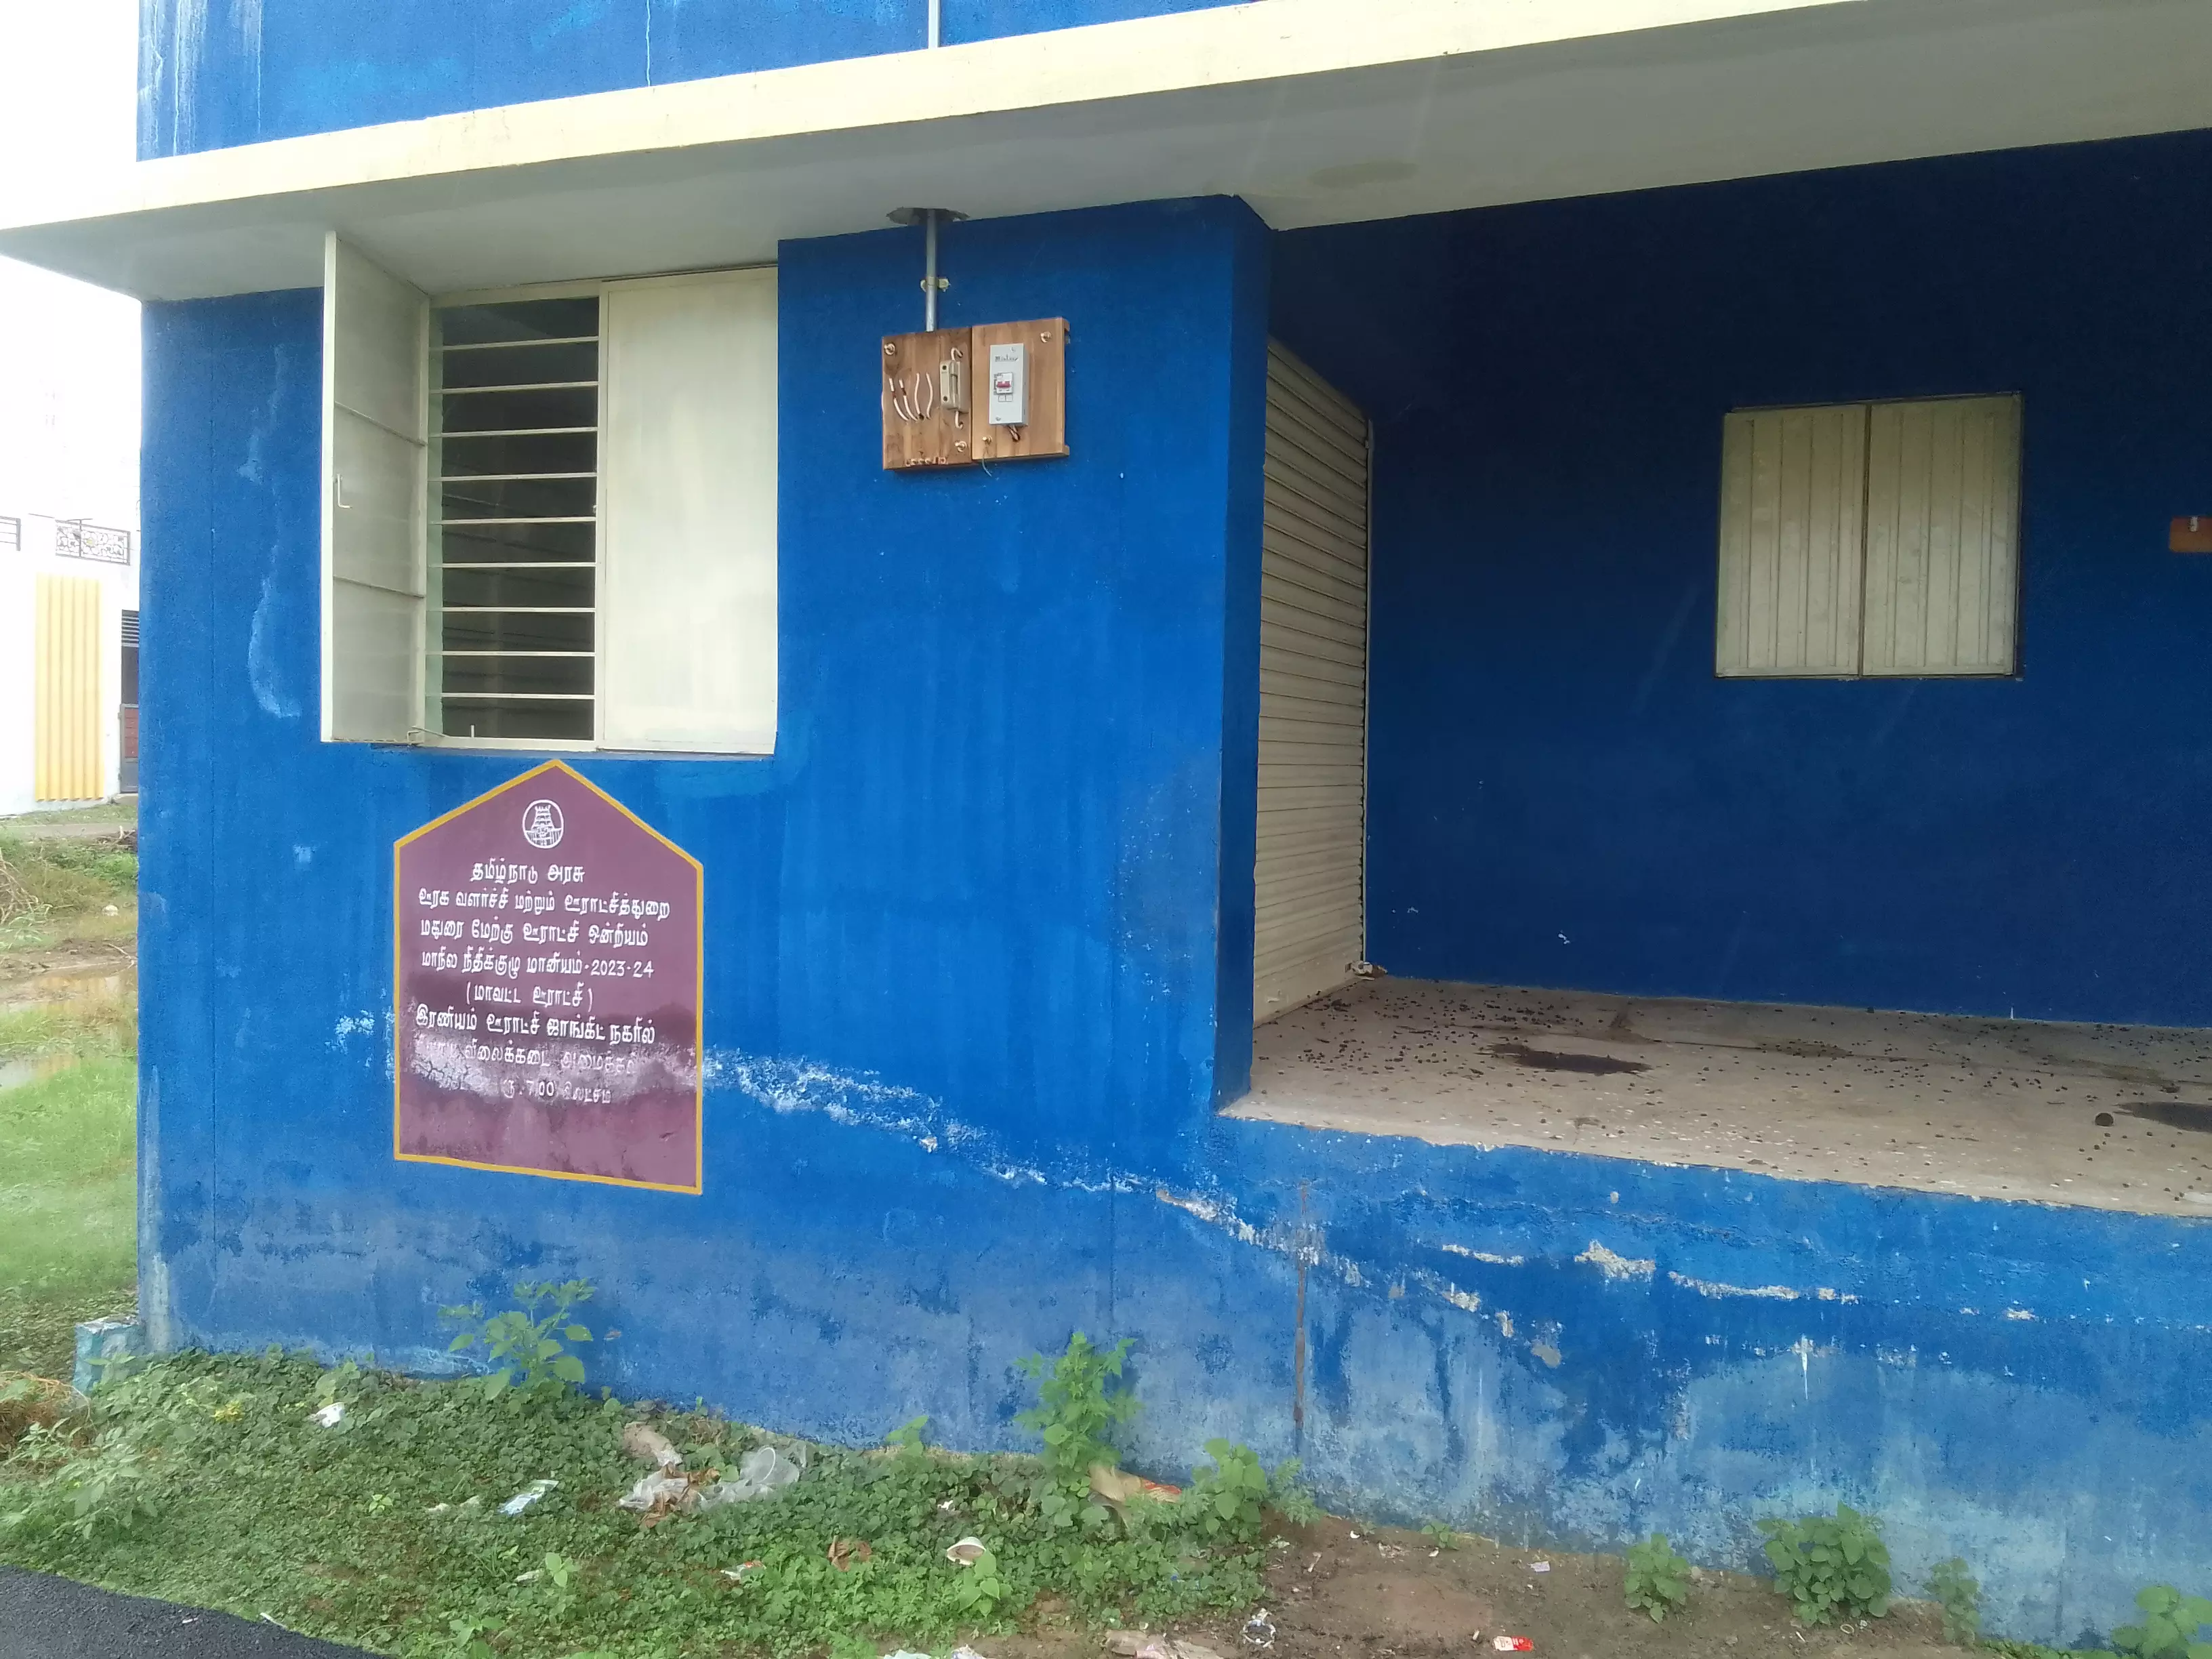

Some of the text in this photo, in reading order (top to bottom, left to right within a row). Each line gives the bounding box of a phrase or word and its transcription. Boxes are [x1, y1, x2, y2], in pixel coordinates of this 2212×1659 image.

[469, 857, 586, 885] தமிழ்நாடு அரசு
[418, 886, 671, 922] ஊரக வளர்ச்சி மற்றும் ஊராட்சித்துறை
[419, 915, 649, 949] மதுரை மேற்கு ஊராட்சி ஒன்றியம்
[421, 945, 459, 972] மாநில
[461, 944, 521, 980] நிதிக்குழு
[415, 1002, 478, 1031] இரணியம்
[485, 1009, 541, 1036] ஊராட்சி
